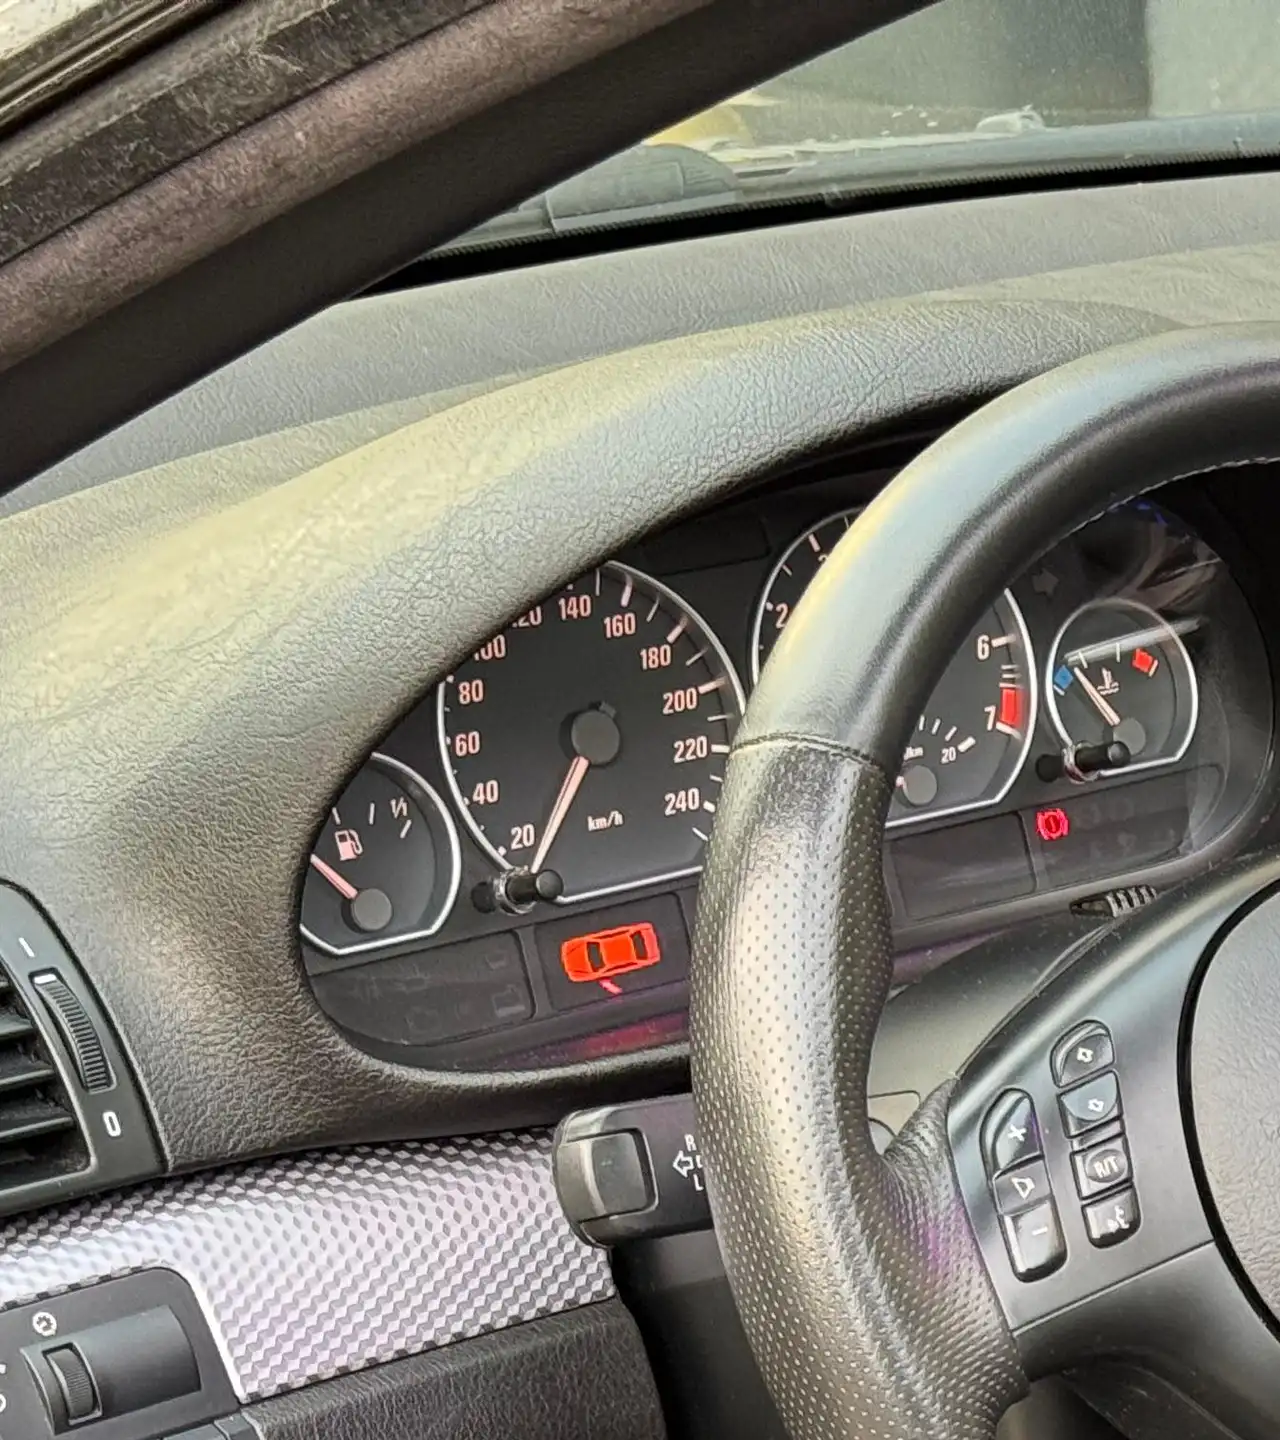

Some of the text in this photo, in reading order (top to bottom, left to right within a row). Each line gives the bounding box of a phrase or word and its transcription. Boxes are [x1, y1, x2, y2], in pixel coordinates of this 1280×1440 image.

[512, 606, 542, 628] 20
[558, 594, 592, 621] 140
[603, 612, 636, 639] 160
[640, 644, 672, 670] 180
[977, 635, 990, 660] 6
[458, 679, 484, 705] 80
[662, 687, 698, 715] 200
[984, 705, 996, 731] 7
[455, 731, 480, 757] 60
[673, 735, 708, 764] 220
[941, 746, 957, 764] 20
[472, 780, 499, 805] 40
[664, 787, 700, 816] 240
[587, 809, 624, 832] km/h
[510, 823, 535, 850] 20
